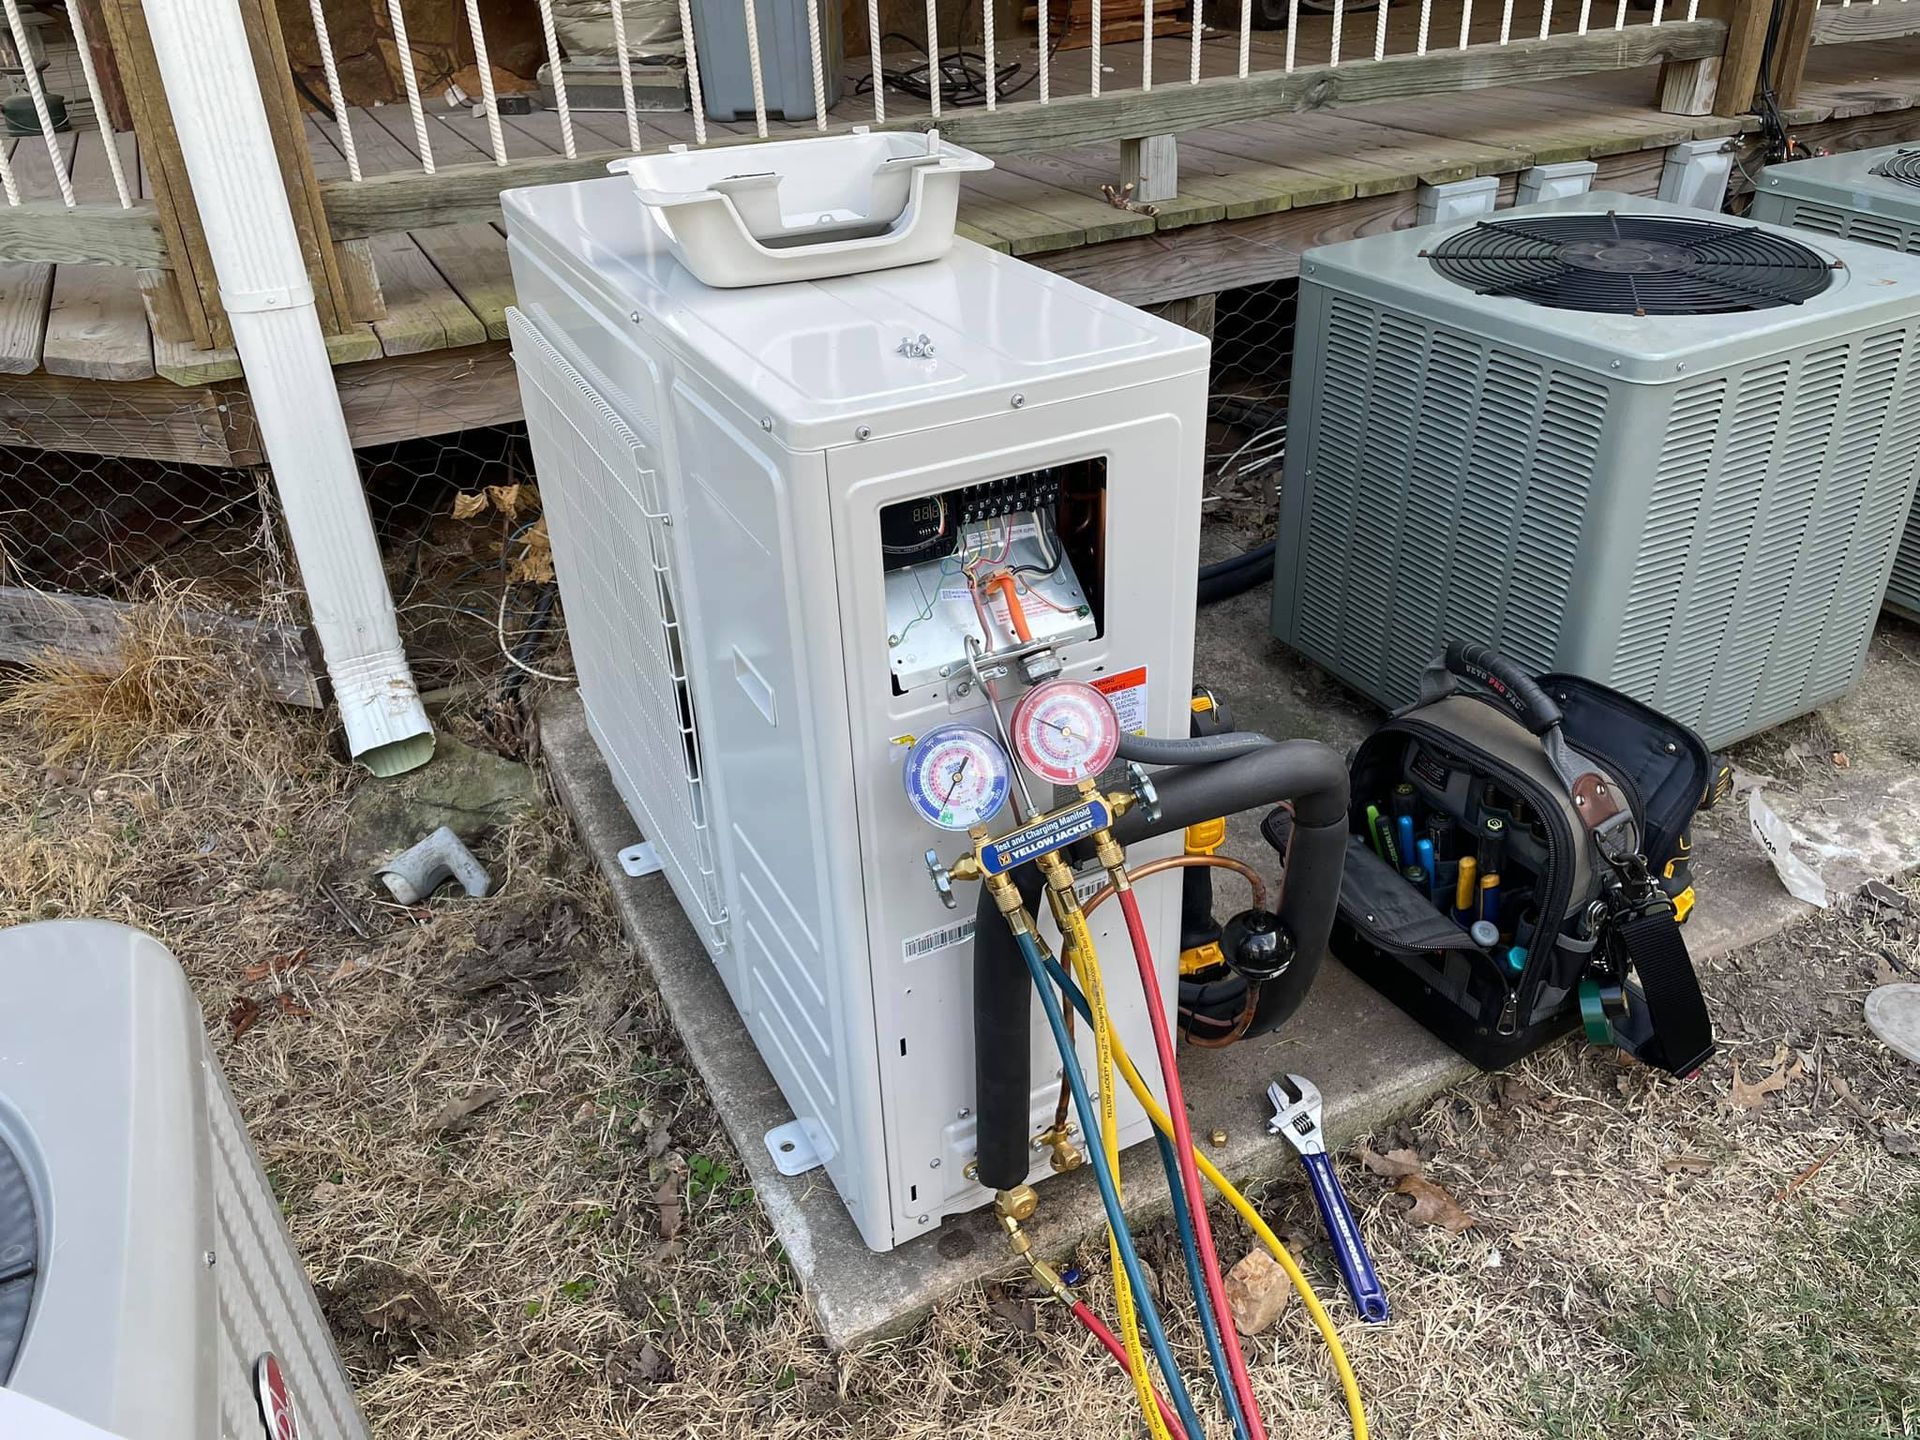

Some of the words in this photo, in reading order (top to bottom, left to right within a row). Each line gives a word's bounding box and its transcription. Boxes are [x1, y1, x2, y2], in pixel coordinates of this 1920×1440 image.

[1466, 664, 1487, 680] VETO
[995, 841, 1011, 853] Test
[1011, 835, 1026, 848] and
[1026, 822, 1060, 840] Charging
[1059, 807, 1091, 826] Manifold
[1012, 838, 1055, 859] YELLOW
[1055, 819, 1094, 842] JACKET
[1105, 1094, 1113, 1119] YELLOW
